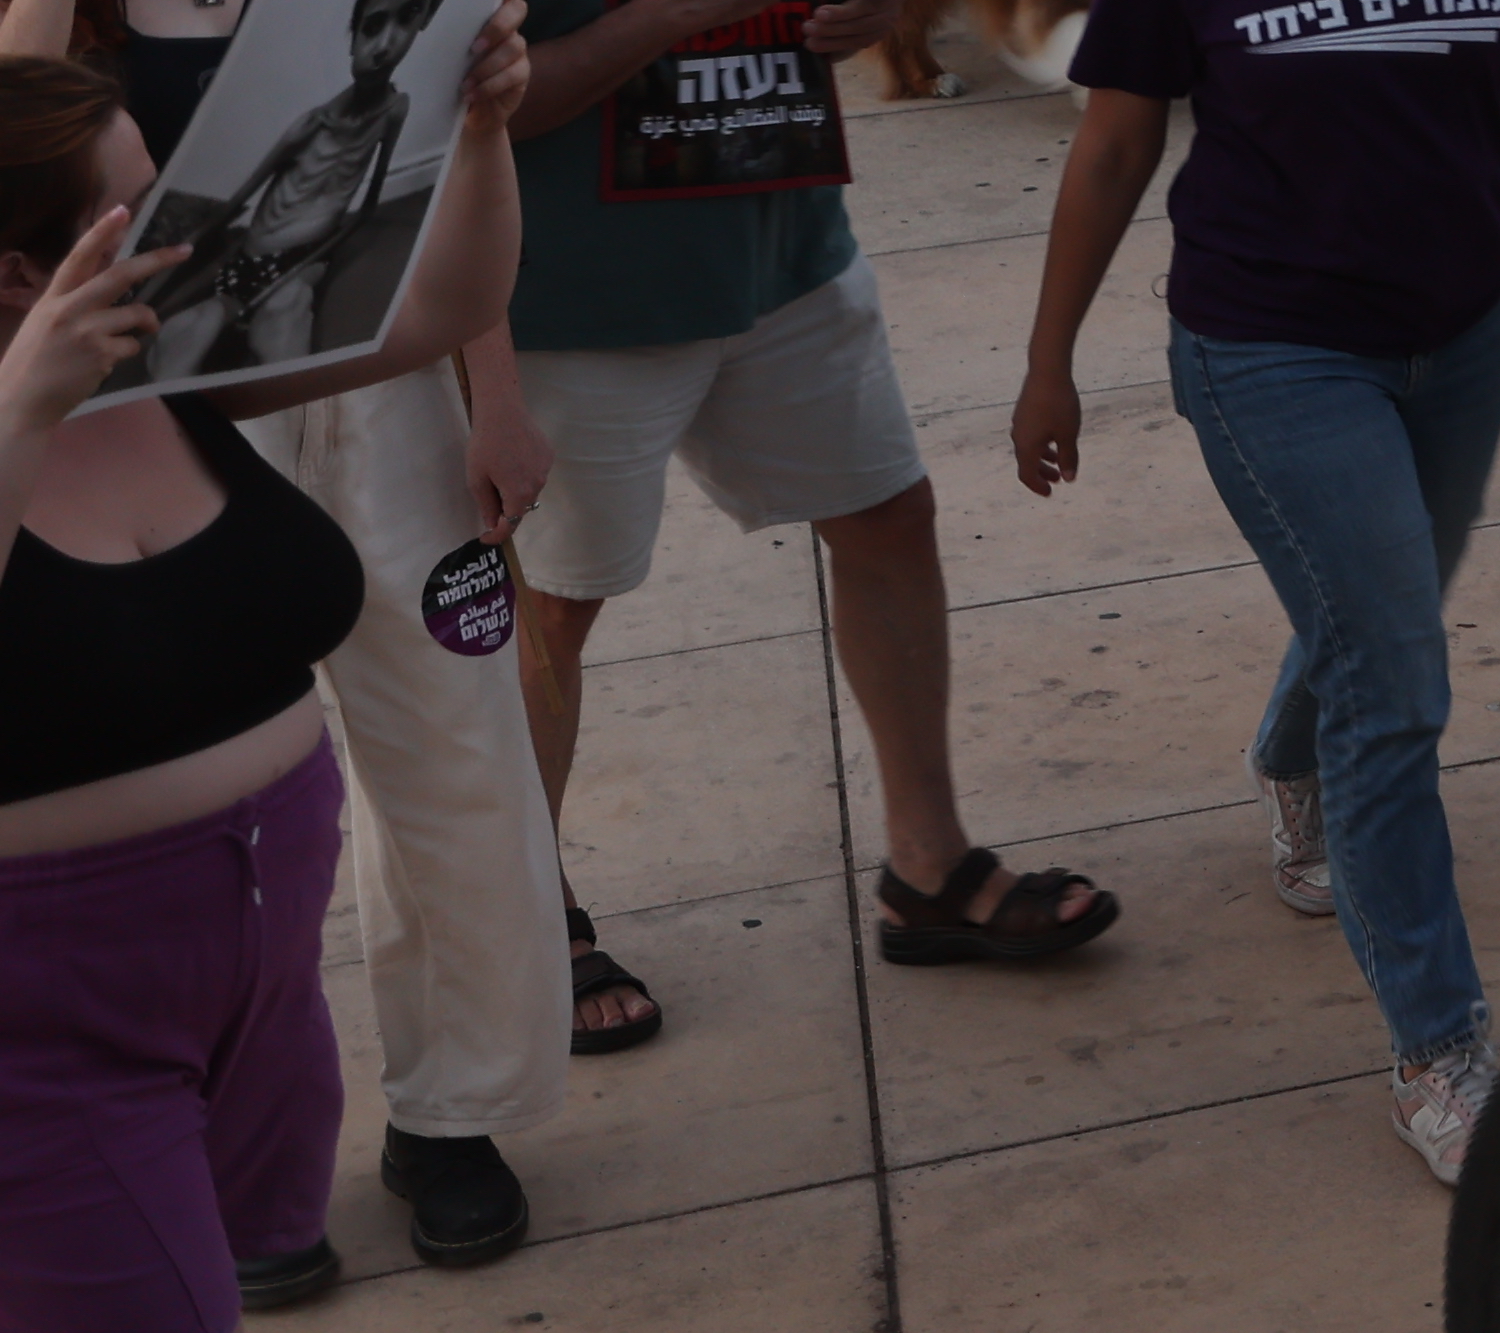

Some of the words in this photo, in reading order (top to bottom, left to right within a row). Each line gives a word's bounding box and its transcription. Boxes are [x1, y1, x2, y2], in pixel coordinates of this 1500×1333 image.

[677, 51, 804, 104] בעזה
[442, 553, 489, 586] للحرب
[437, 569, 497, 607] למלחמה
[458, 604, 489, 628] سلام
[460, 613, 499, 642] שלום
